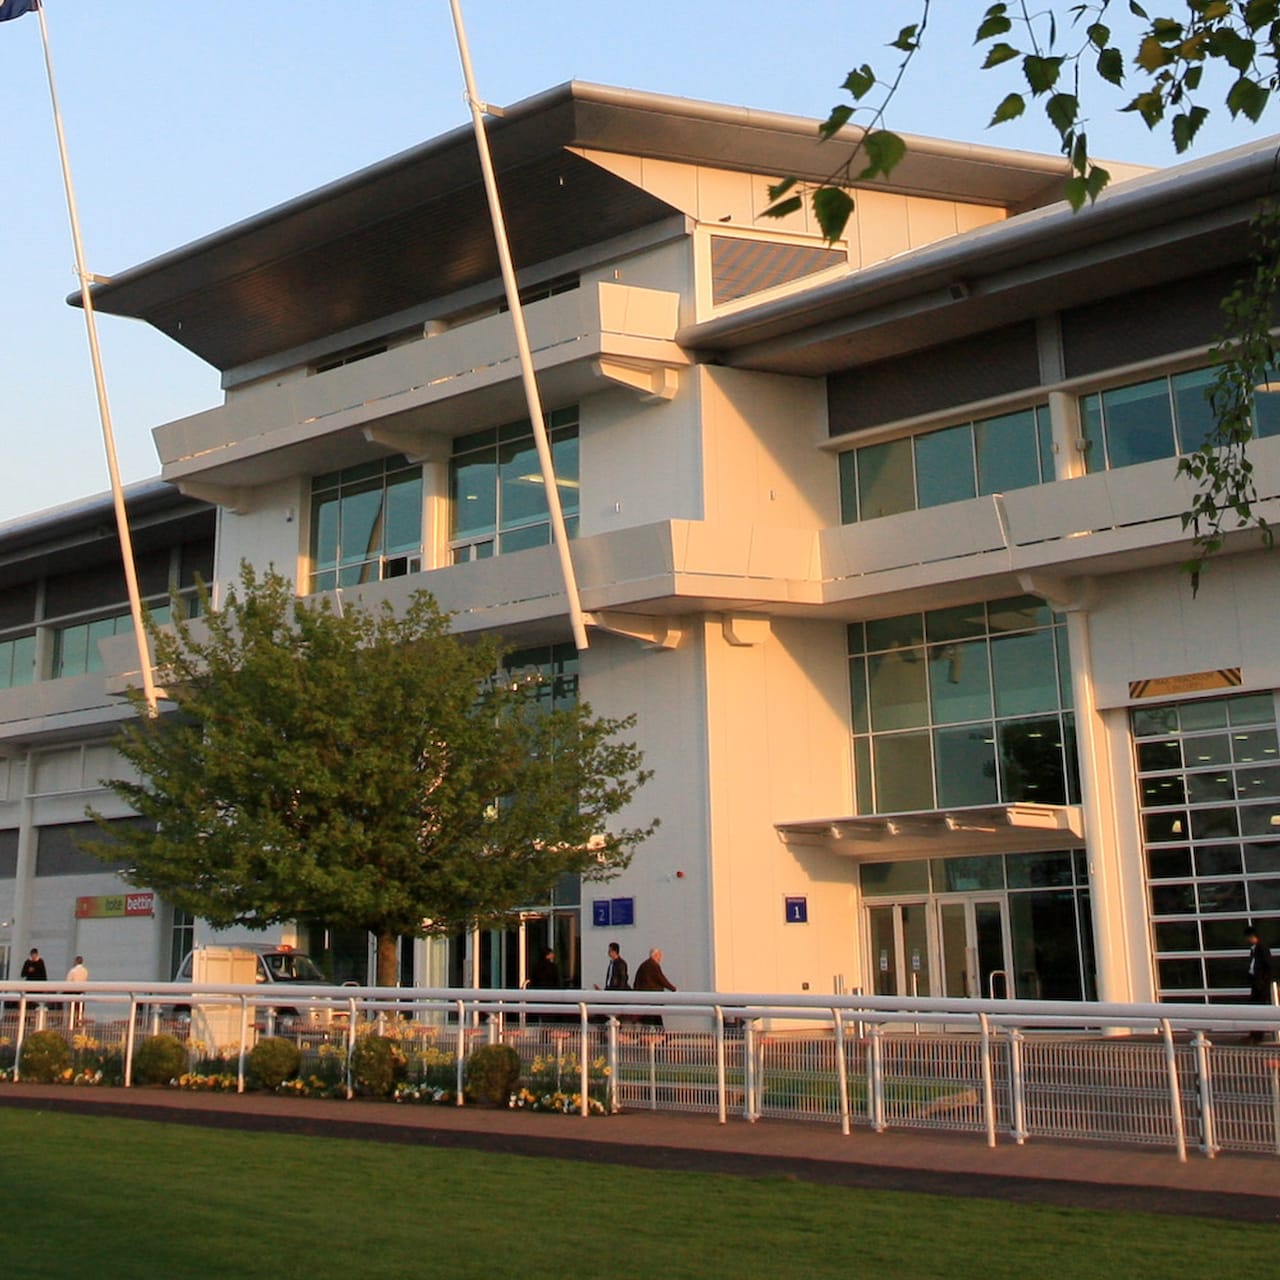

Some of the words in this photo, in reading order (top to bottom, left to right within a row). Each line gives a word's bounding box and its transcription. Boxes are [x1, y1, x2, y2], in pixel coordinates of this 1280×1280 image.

[127, 895, 154, 910] bettin
[598, 909, 605, 921] 2
[794, 905, 800, 919] 1
